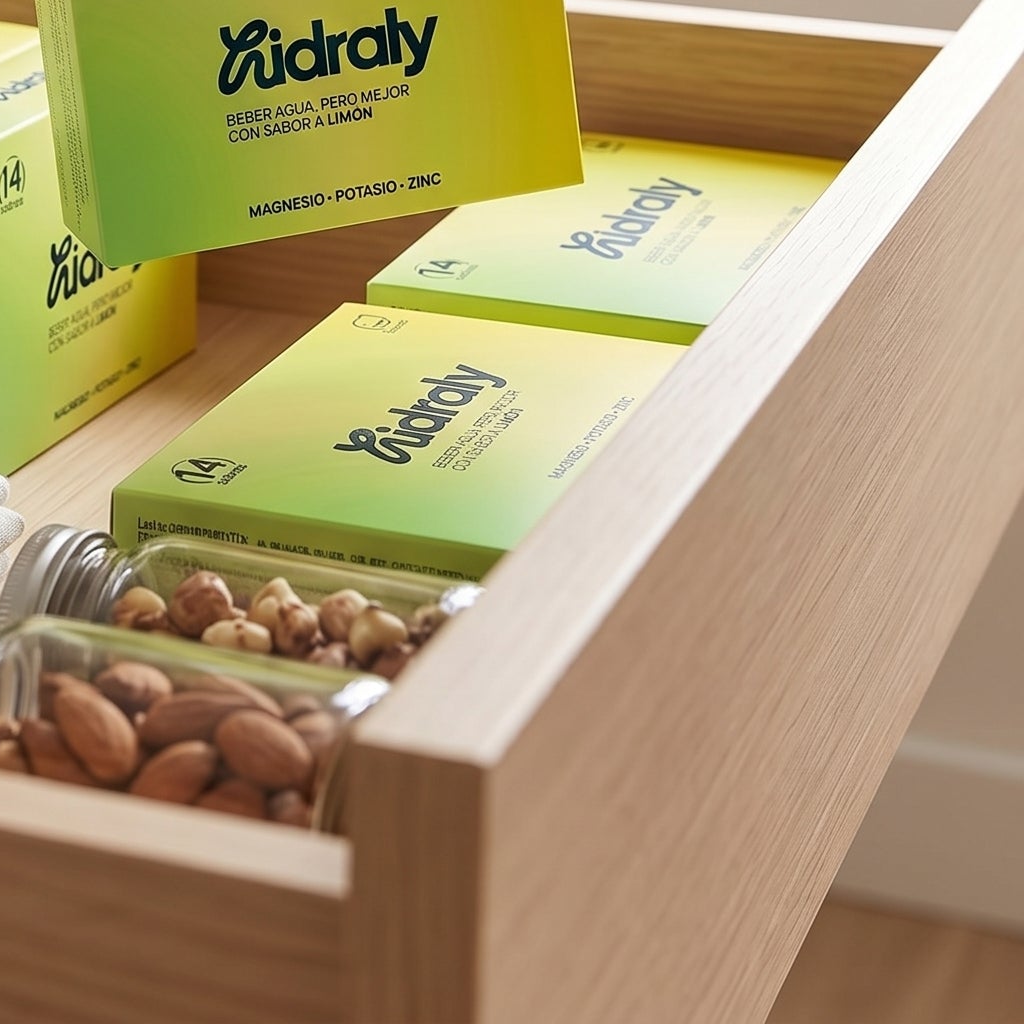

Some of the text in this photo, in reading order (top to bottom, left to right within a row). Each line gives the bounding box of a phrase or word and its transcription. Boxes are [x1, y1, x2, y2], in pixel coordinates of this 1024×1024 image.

[226, 107, 273, 127] BEBER
[320, 93, 358, 111] PERO
[361, 84, 410, 104] MEJOR
[228, 106, 373, 143] CON SABOR A LIMÓN
[2, 159, 22, 199] 14
[249, 173, 442, 218] MAGNESIO POTASIO ZINC
[175, 459, 227, 479] 14
